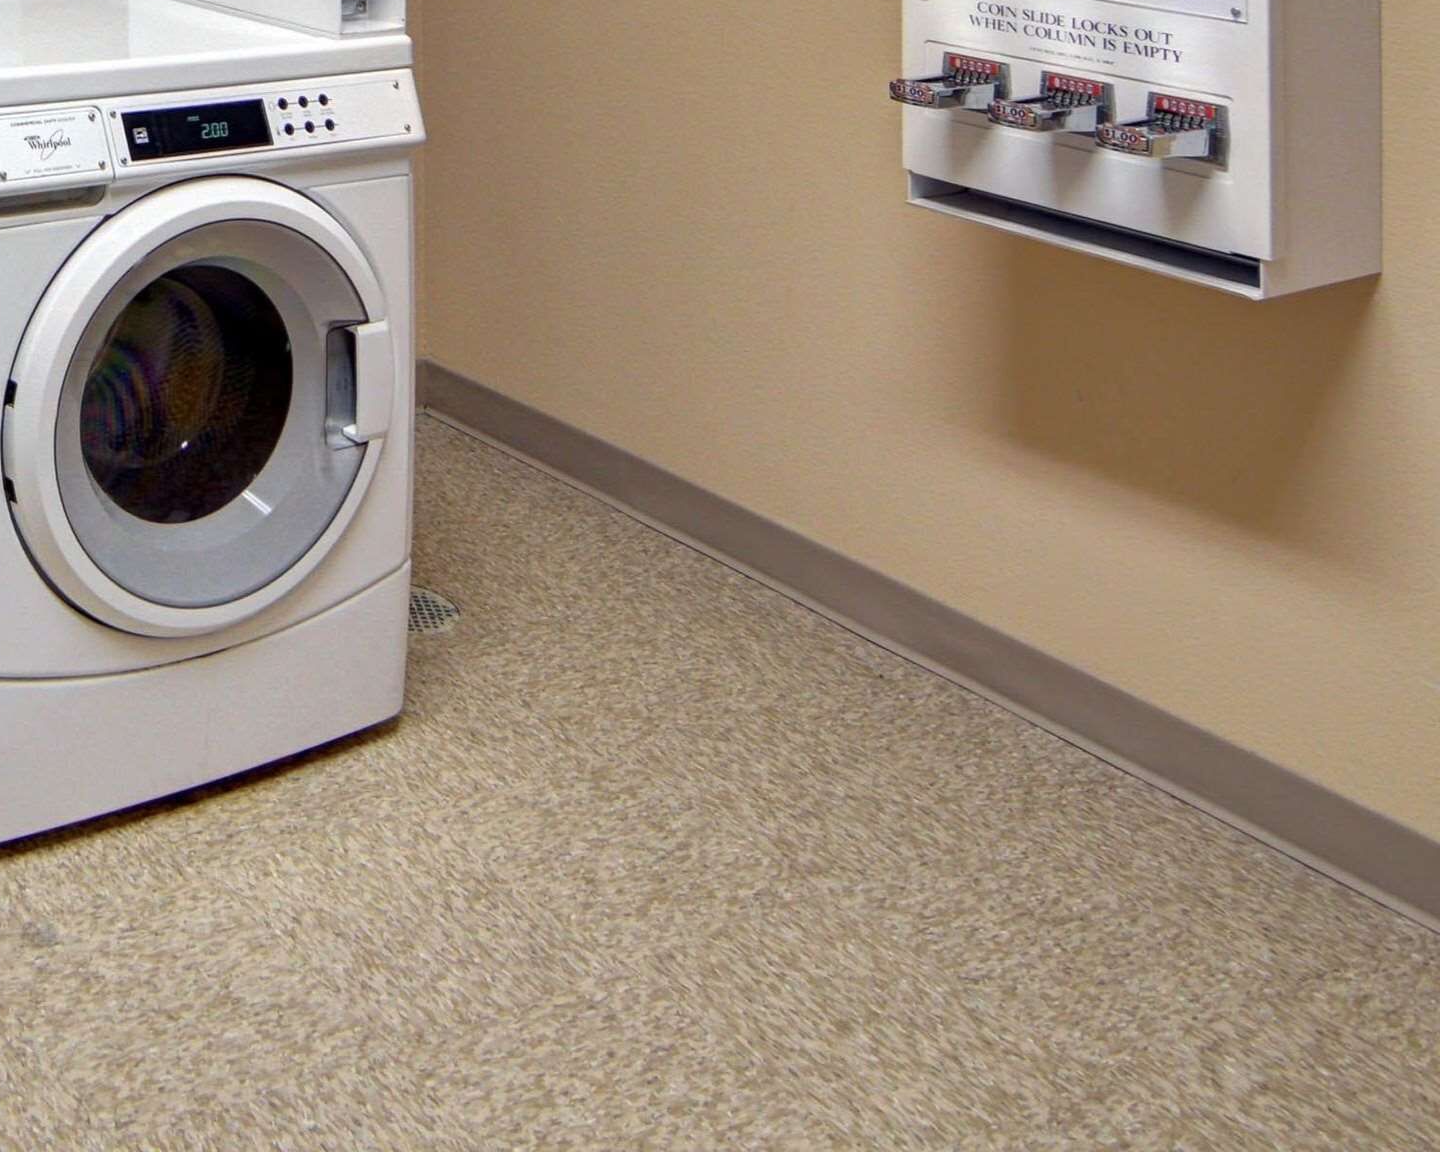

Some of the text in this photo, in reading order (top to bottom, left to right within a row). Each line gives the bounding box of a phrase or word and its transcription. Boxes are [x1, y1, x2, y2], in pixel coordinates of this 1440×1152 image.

[969, 14, 1018, 33] WHEN
[1023, 24, 1096, 47] COLUMN
[1103, 39, 1117, 52] IS
[1123, 41, 1184, 64] EMPTY
[976, 1, 1173, 45] COIN SLIDE LOCKS OUT
[26, 136, 72, 151] Whirlpool
